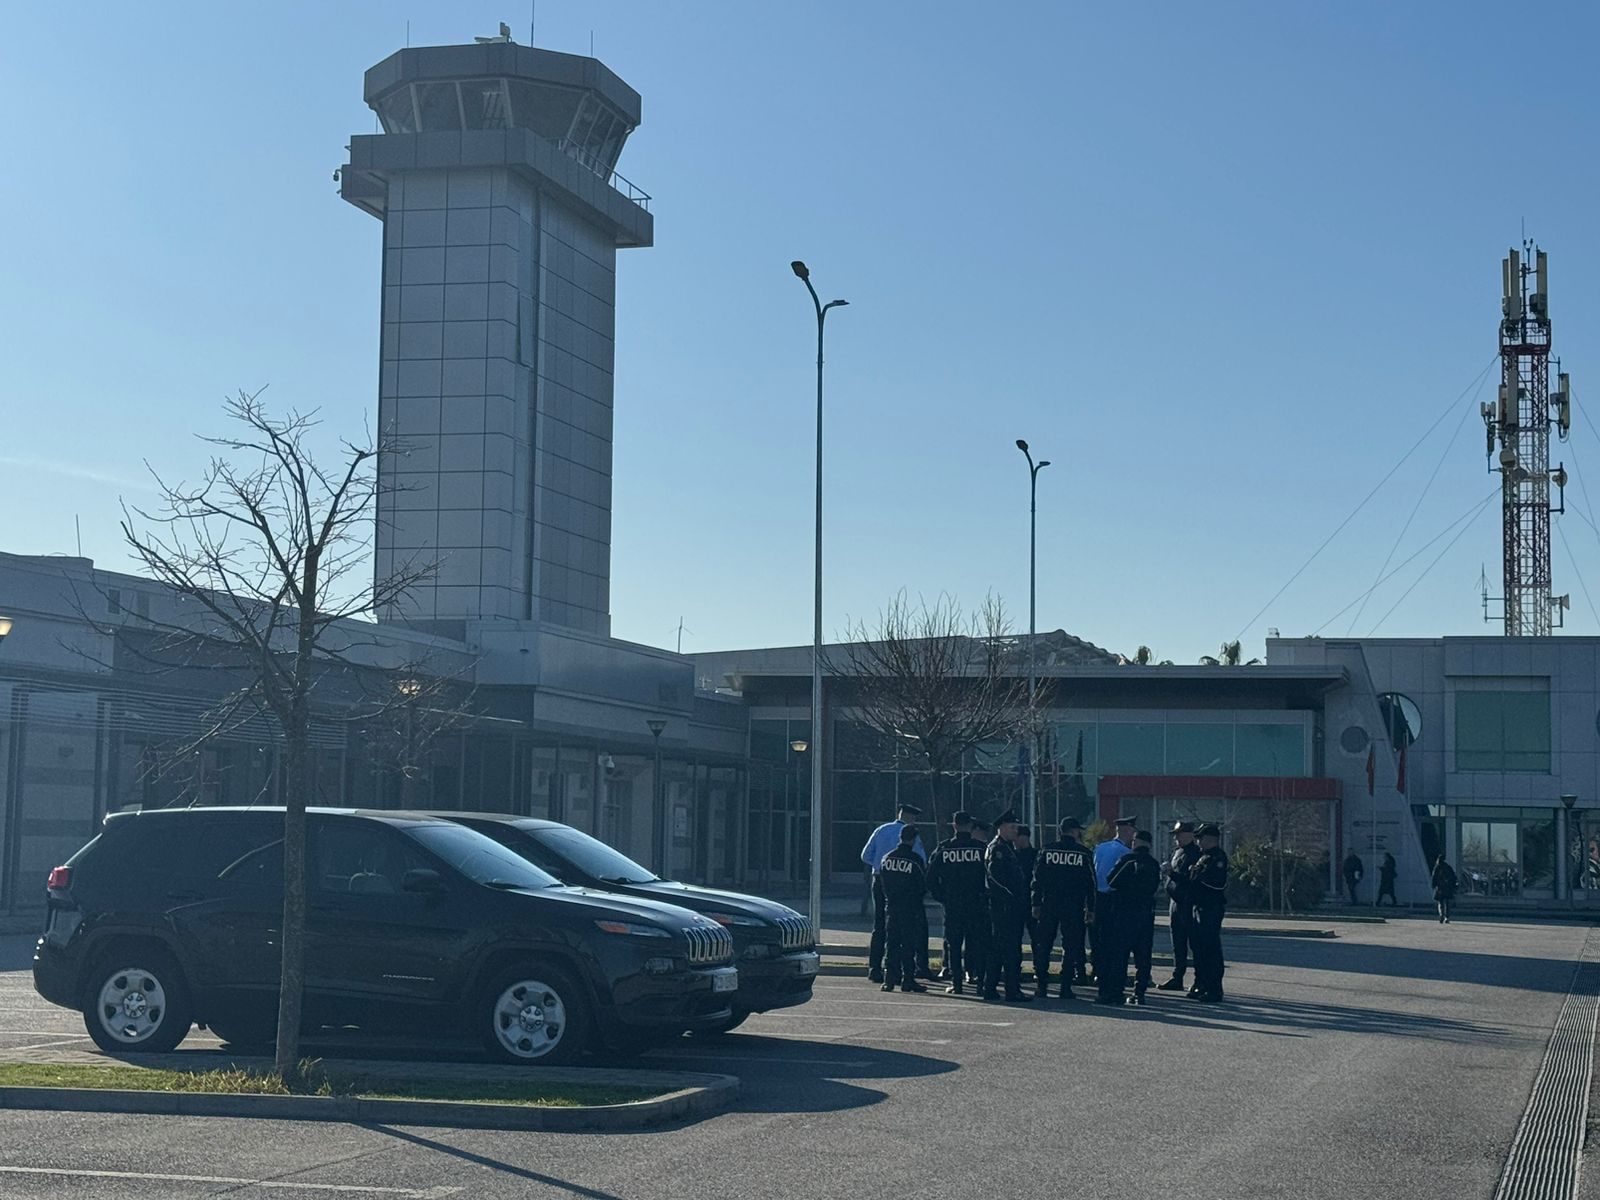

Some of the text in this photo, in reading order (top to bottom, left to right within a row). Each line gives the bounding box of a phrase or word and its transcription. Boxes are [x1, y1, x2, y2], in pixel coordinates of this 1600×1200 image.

[943, 850, 981, 863] POLICIA
[1046, 852, 1083, 867] POLICIA
[880, 859, 912, 874] POLICIA
